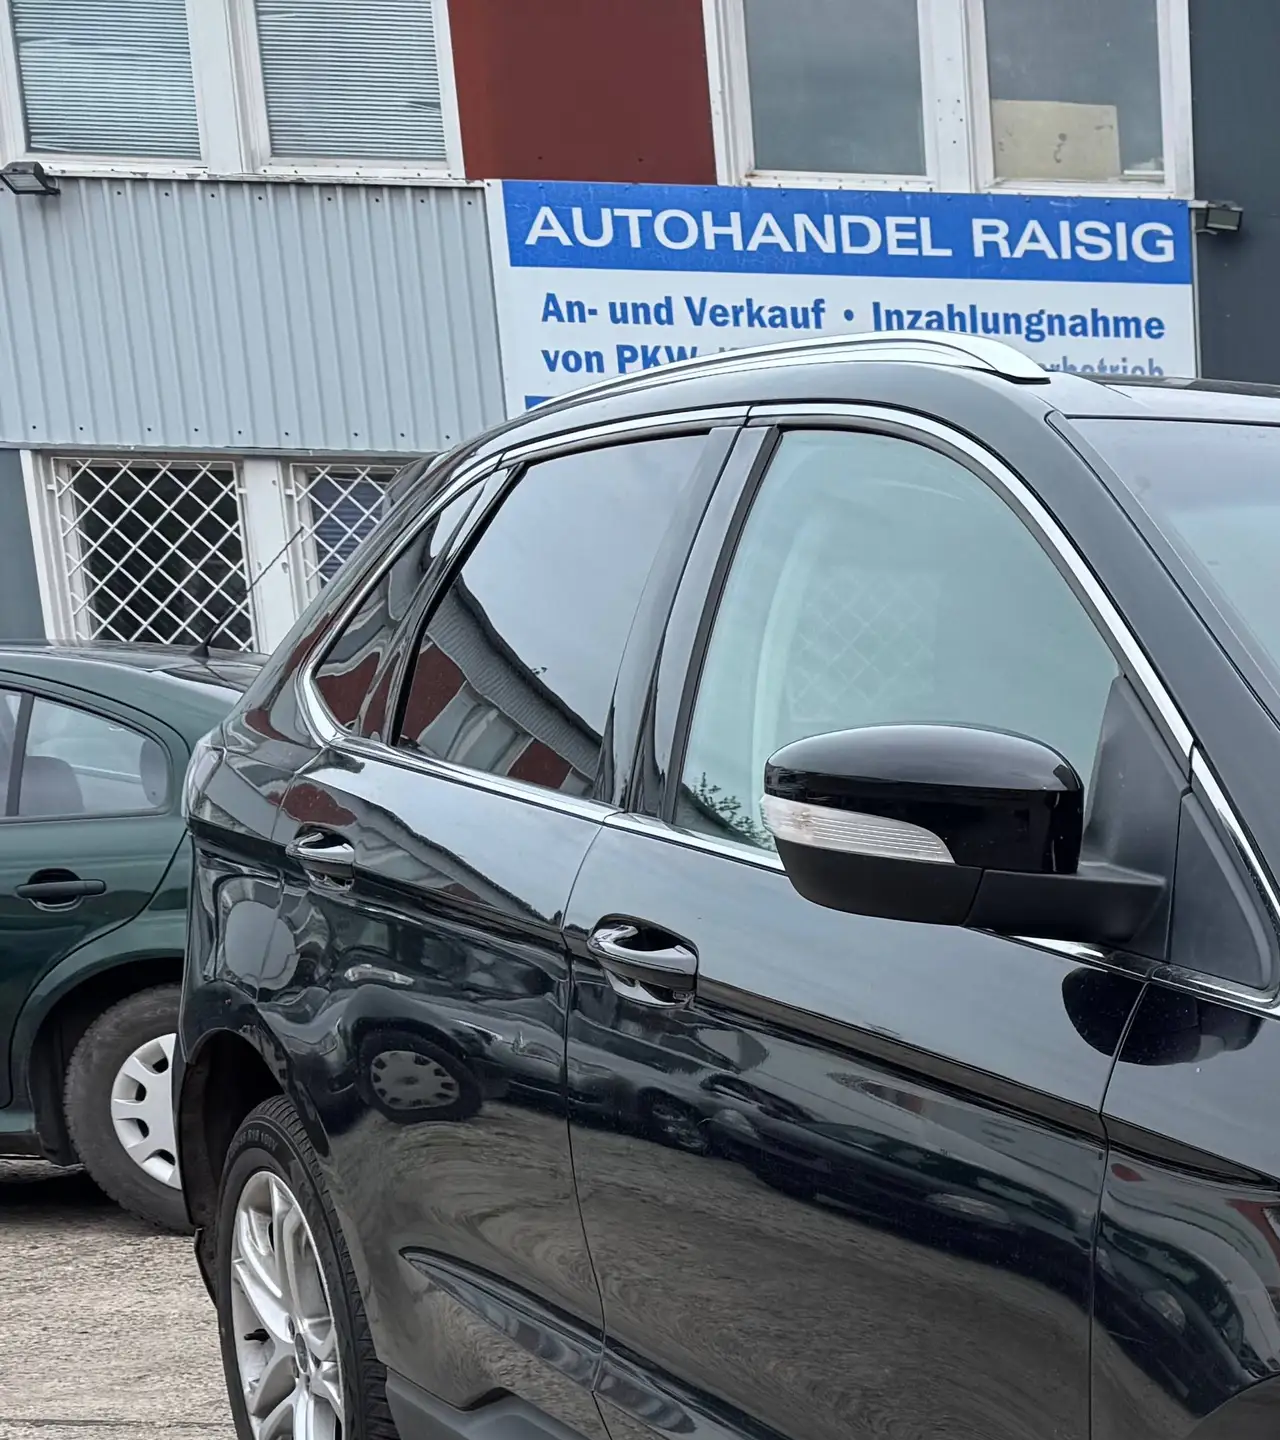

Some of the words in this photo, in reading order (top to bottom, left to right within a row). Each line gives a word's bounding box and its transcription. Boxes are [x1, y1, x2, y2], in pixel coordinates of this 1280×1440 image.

[525, 206, 952, 257] AUTOHANDEL
[971, 218, 1174, 264] RAISIG
[541, 292, 598, 323] An-
[608, 296, 674, 326] und
[684, 296, 826, 330] Verkauf
[872, 301, 1165, 343] Inzahlungnahme
[541, 349, 605, 374] von
